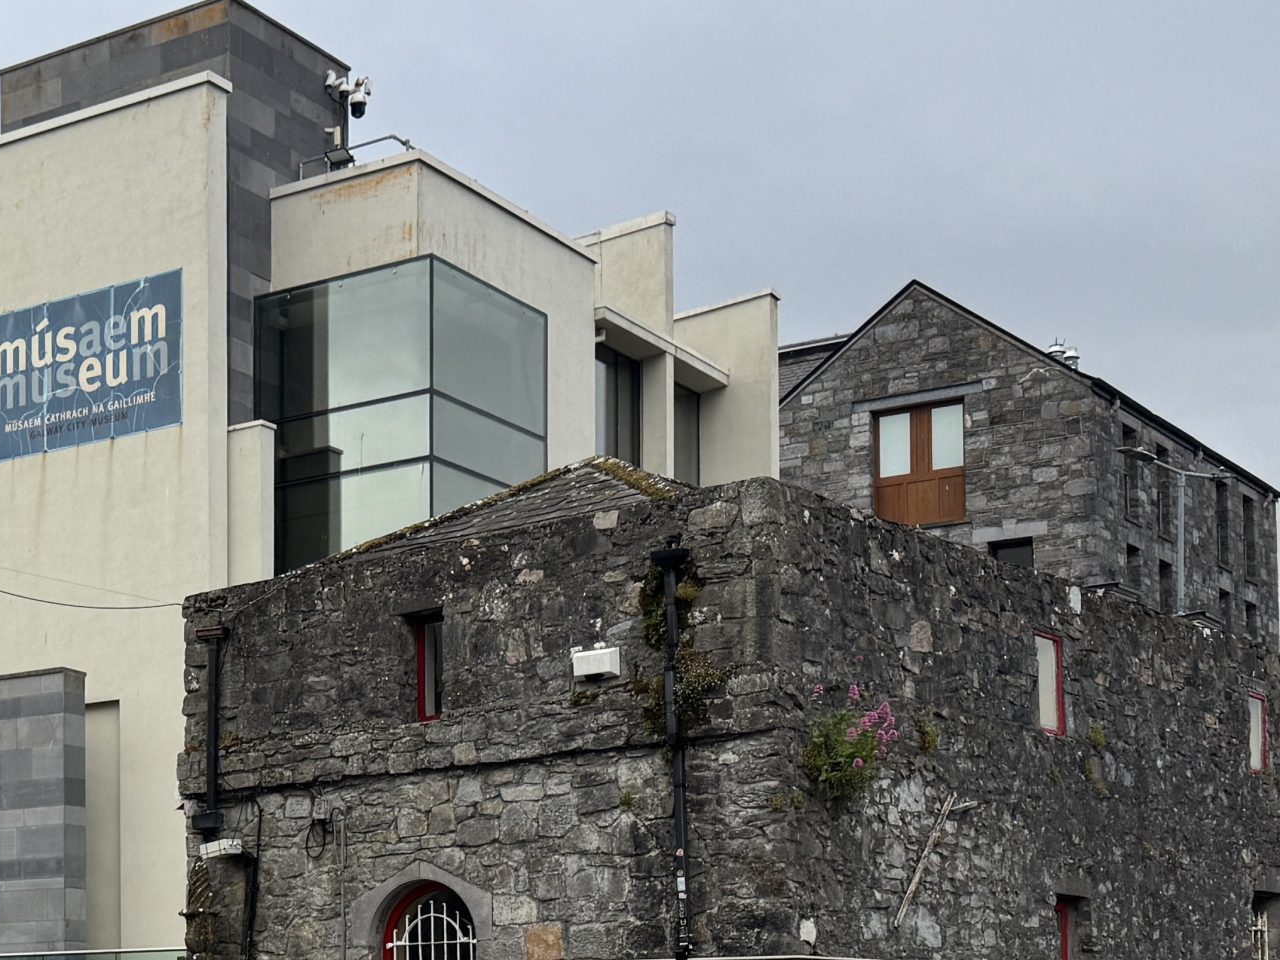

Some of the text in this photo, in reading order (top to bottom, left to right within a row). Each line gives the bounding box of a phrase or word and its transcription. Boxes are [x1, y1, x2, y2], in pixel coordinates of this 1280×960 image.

[45, 406, 88, 424] CATHRACH
[92, 403, 104, 414] NA
[108, 391, 156, 411] GAILLIMHE
[30, 411, 128, 439] GALWAY CITY MUSEUM
